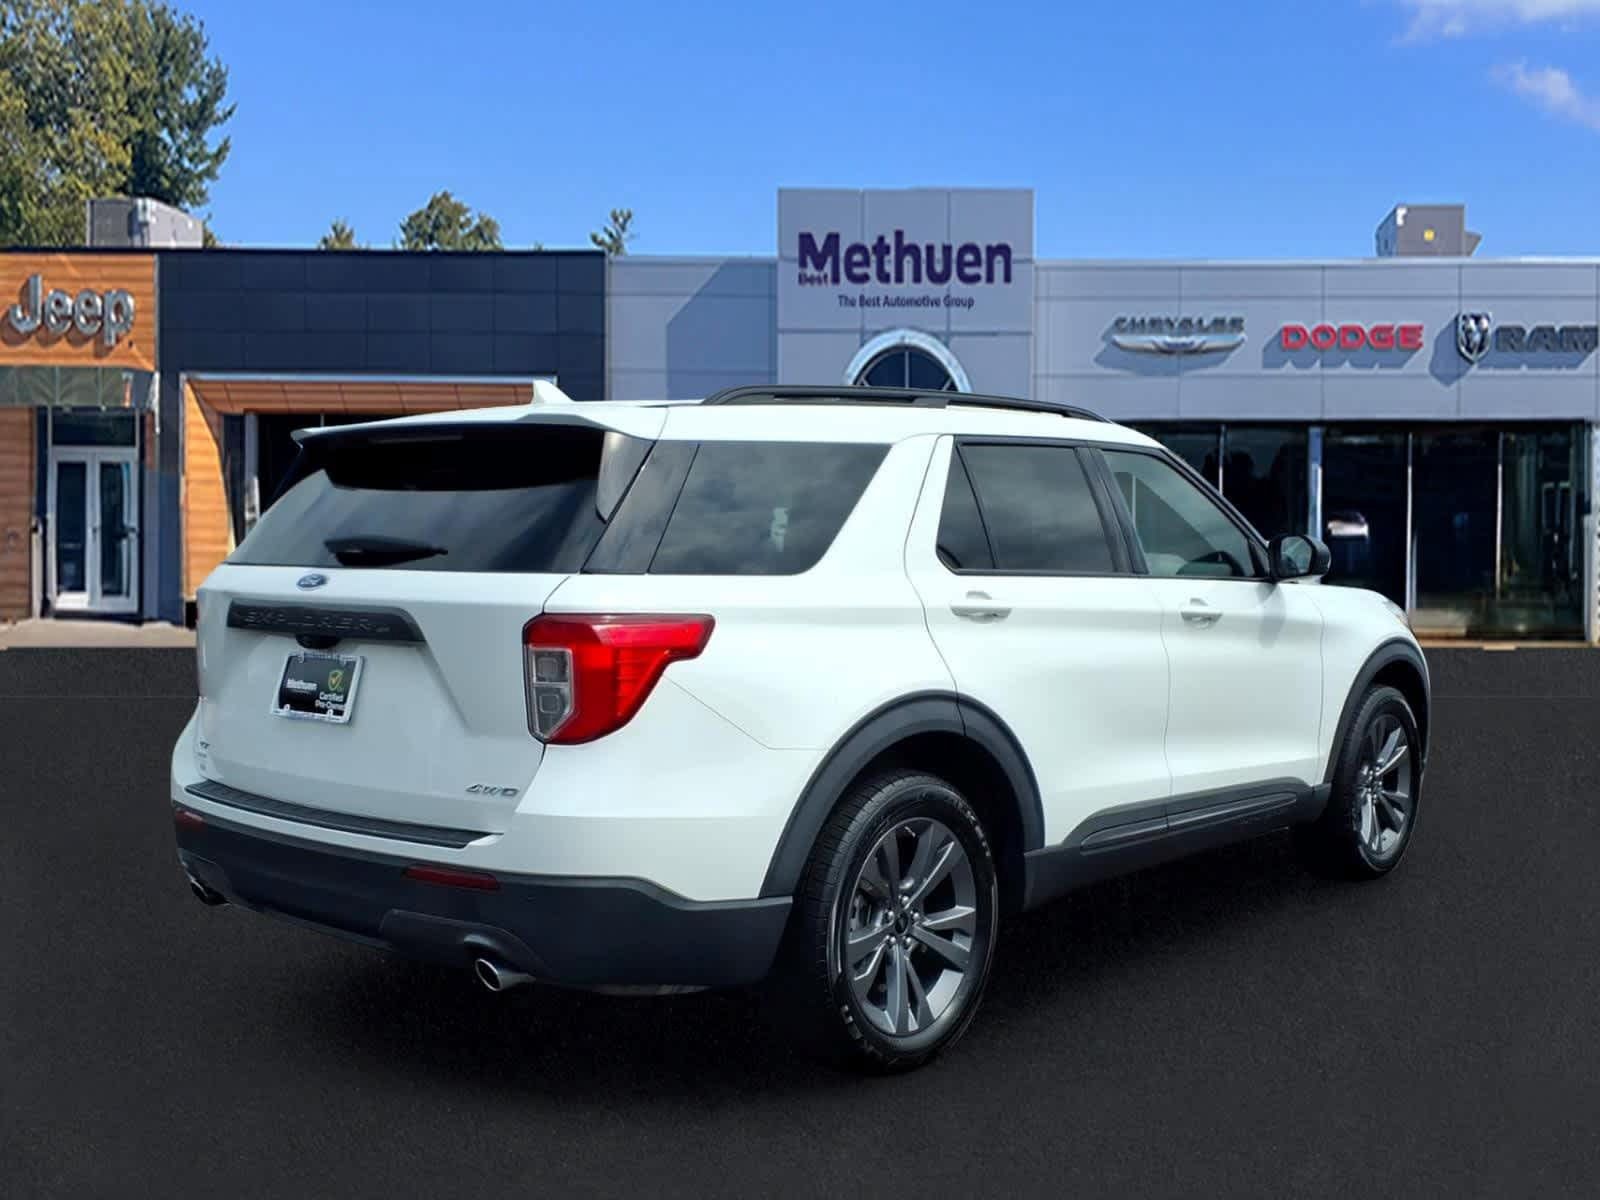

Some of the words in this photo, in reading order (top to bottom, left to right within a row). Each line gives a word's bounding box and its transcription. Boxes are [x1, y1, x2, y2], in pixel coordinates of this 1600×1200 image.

[798, 229, 1012, 284] Methuen
[798, 272, 829, 286] Best
[9, 273, 136, 346] Jeep
[838, 295, 857, 307] The
[858, 295, 881, 307] Best
[882, 295, 941, 307] Automotive
[943, 295, 975, 310] Group
[1114, 316, 1246, 332] CHRYSLER
[1280, 325, 1424, 350] DODGE
[1495, 325, 1599, 352] RAM
